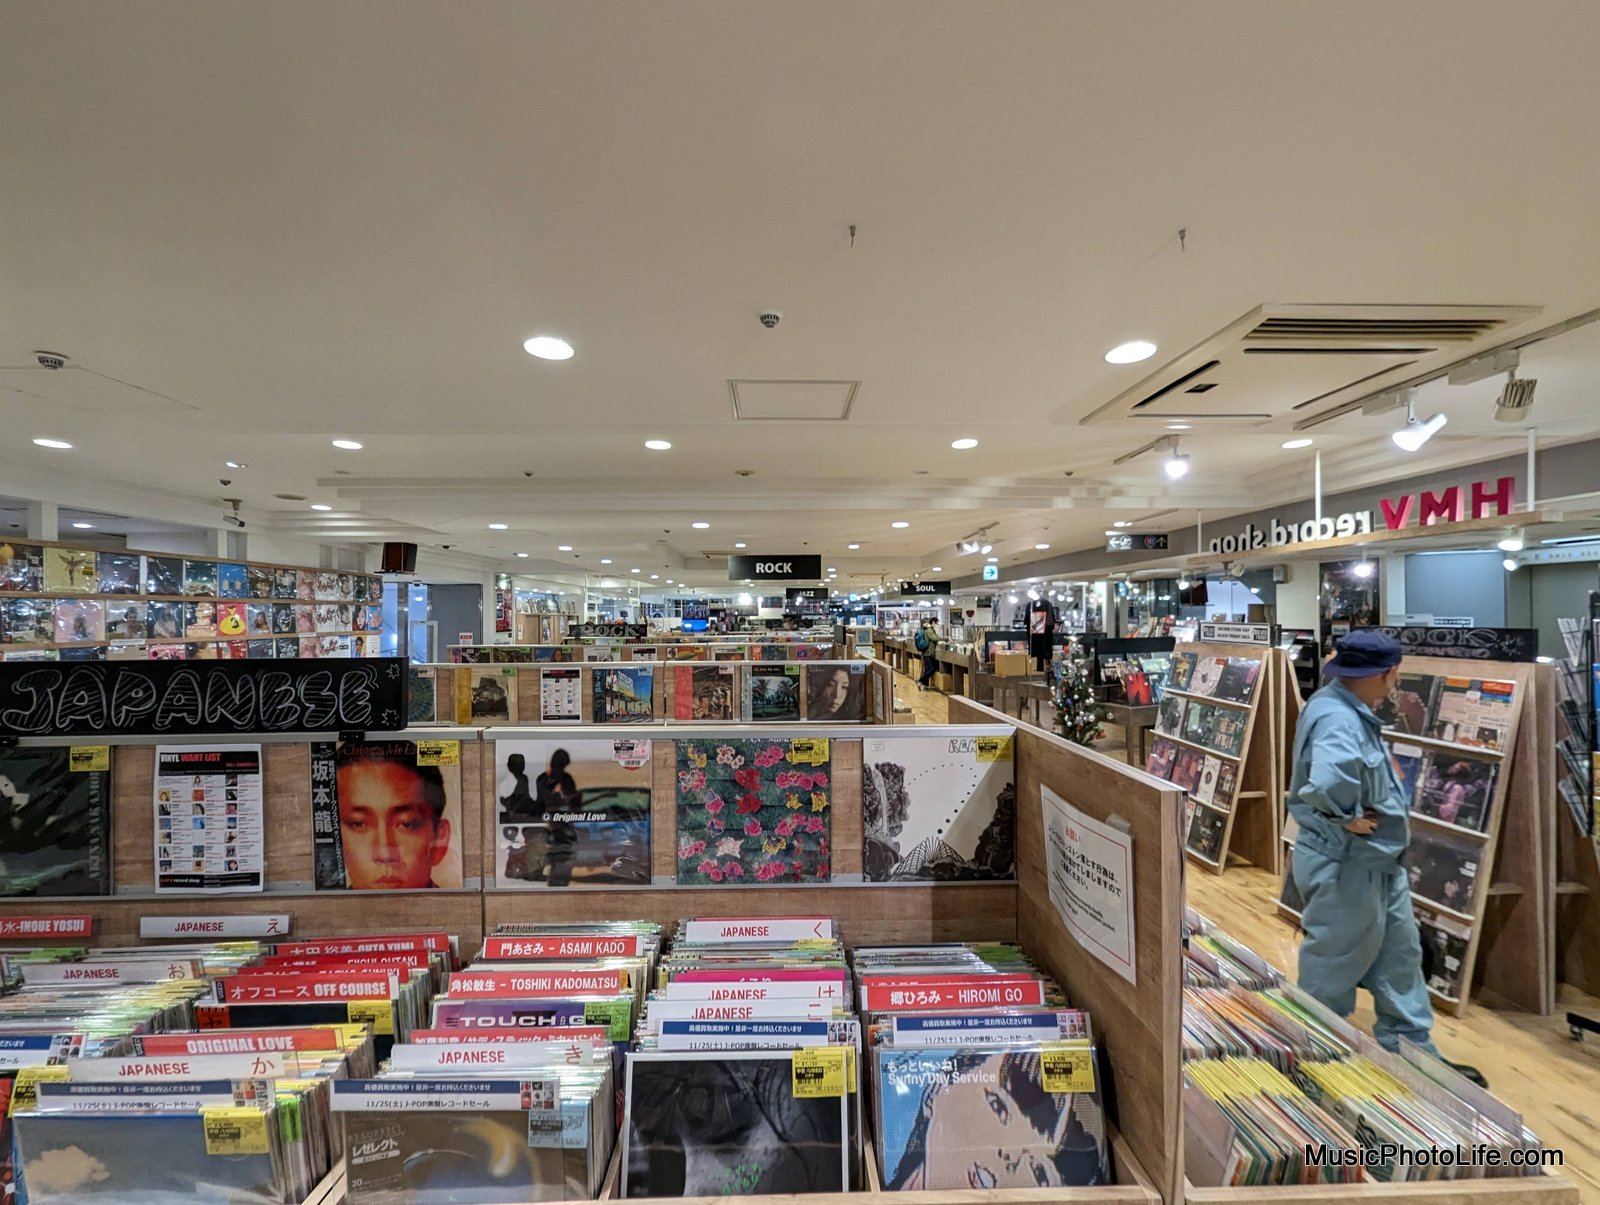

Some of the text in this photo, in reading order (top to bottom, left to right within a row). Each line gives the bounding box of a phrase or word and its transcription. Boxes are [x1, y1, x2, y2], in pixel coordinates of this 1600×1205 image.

[756, 562, 792, 573] ROCK
[2, 667, 376, 731] JAPANESE
[160, 753, 222, 762] VINYL WANT LIST
[312, 760, 334, 844] 坂本龍一
[552, 812, 607, 823] Original Love
[0, 919, 85, 934] 水-INOUE YOSUI
[174, 917, 282, 934] JAPANESE え
[720, 926, 769, 937] JAPANESE
[500, 943, 544, 955] 門あさみ
[559, 942, 592, 955] ASAMI
[596, 941, 625, 954] KADO
[63, 963, 185, 980] JAPANESE お
[231, 981, 386, 1000] オフコース OFF COURSE
[451, 978, 495, 992] 角松敏生
[510, 978, 551, 991] TOSHIKI
[554, 977, 618, 990] KADOMATSU
[707, 989, 767, 1000] JAPANESE
[890, 990, 941, 1005] 郷ひろみ
[959, 989, 1001, 1003] HIROMI
[1005, 988, 1023, 1001] GO
[691, 1007, 753, 1019] JAPANESE
[460, 1016, 556, 1027] TOUCH
[187, 1036, 294, 1053] ORIGINAL LOVE
[438, 1044, 583, 1064] JAPANESE き
[119, 1057, 275, 1077] JAPANESE か
[888, 1070, 997, 1087] Sunny Day Service
